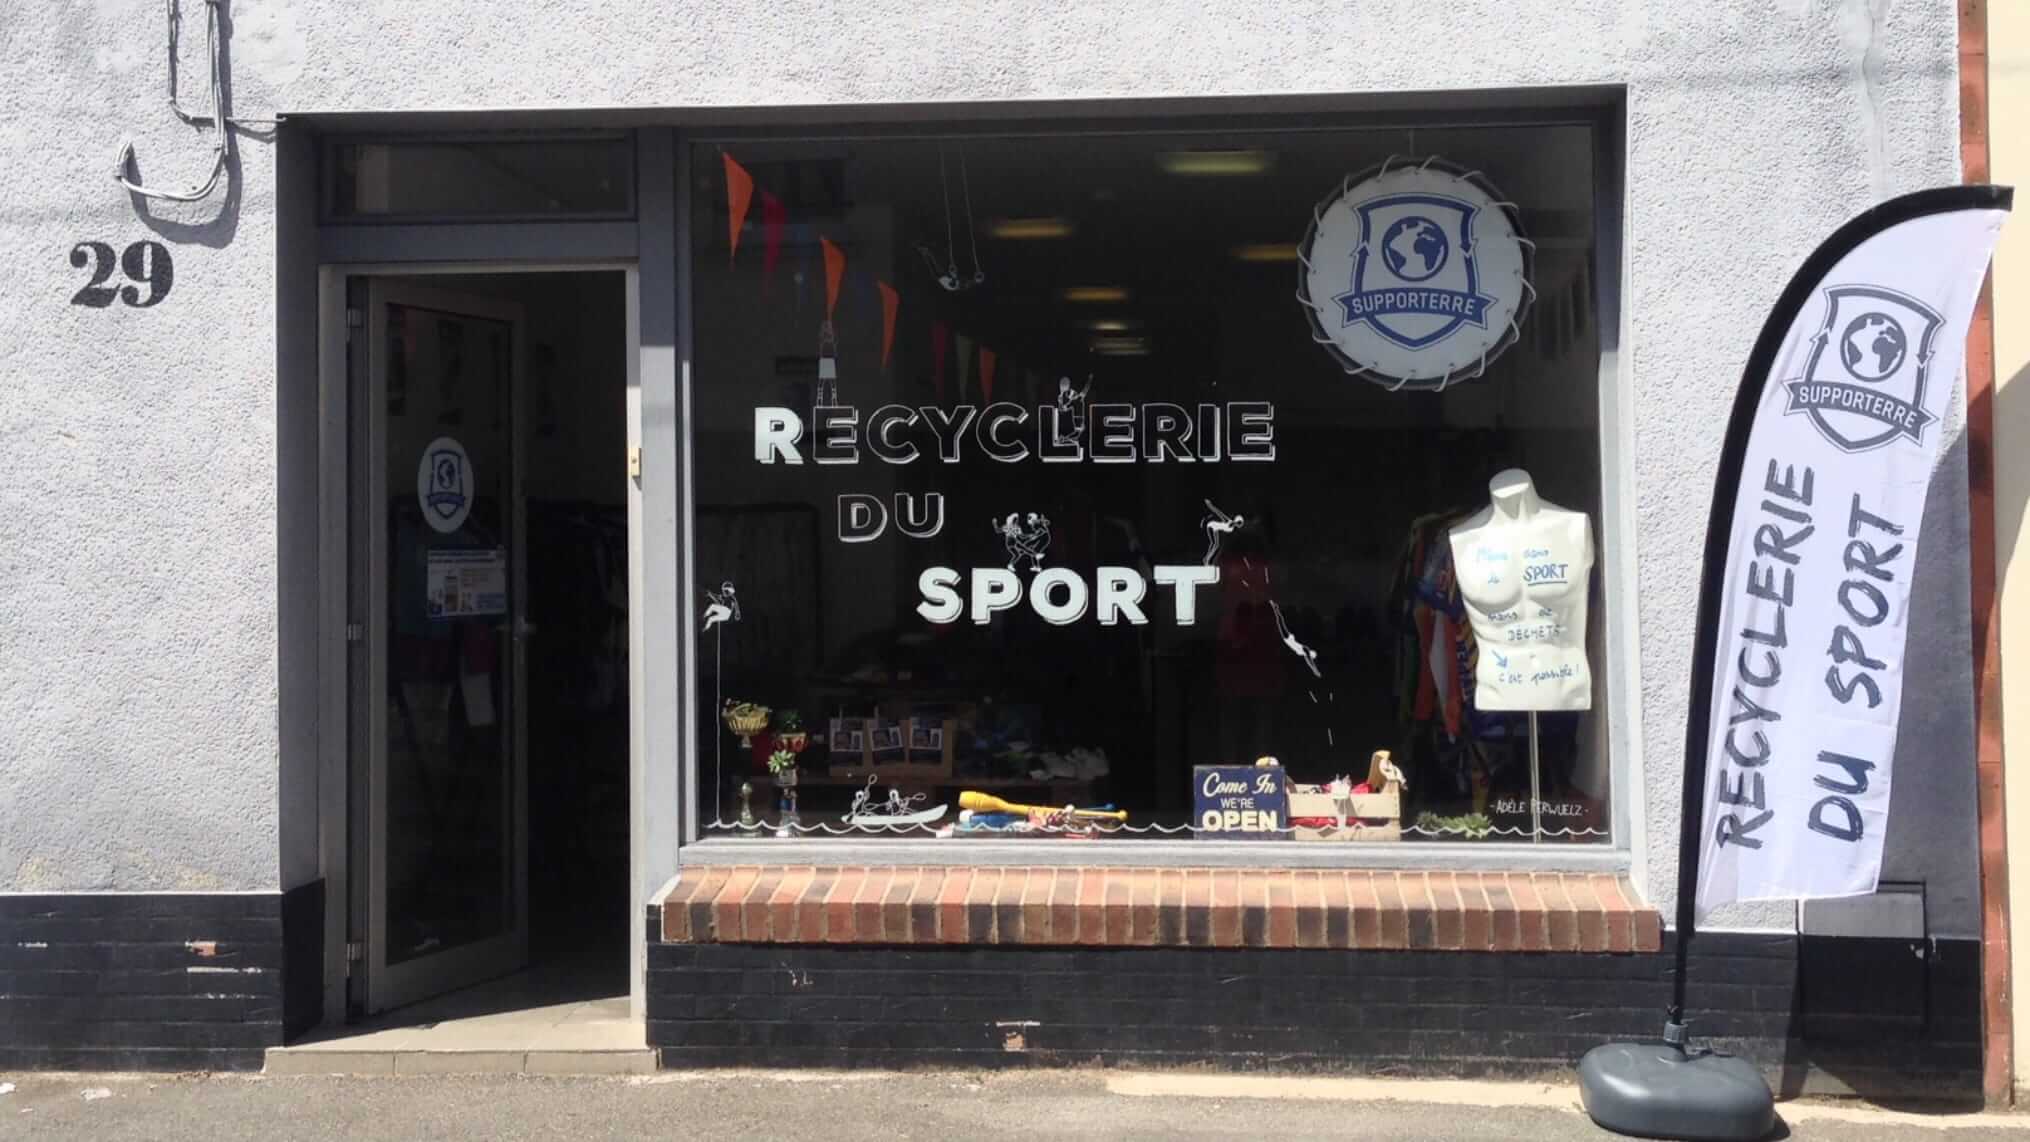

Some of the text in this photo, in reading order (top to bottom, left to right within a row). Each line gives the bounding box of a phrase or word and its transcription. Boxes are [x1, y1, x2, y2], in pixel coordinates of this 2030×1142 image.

[69, 239, 174, 308] 29
[1351, 291, 1476, 316] SUPPORTERRE
[1798, 385, 1919, 429] SUPPORTERRE
[753, 402, 1276, 464] RECYCLERIE
[837, 492, 945, 543] DU
[915, 565, 1221, 626] SPORT
[1523, 564, 1568, 582] SPORT
[1716, 457, 1816, 850] RECYCLERIE
[1807, 492, 1905, 842] DU SPORT
[1202, 771, 1277, 797] Come In
[1220, 797, 1255, 809] WE'RE
[1202, 809, 1277, 832] OPEN
